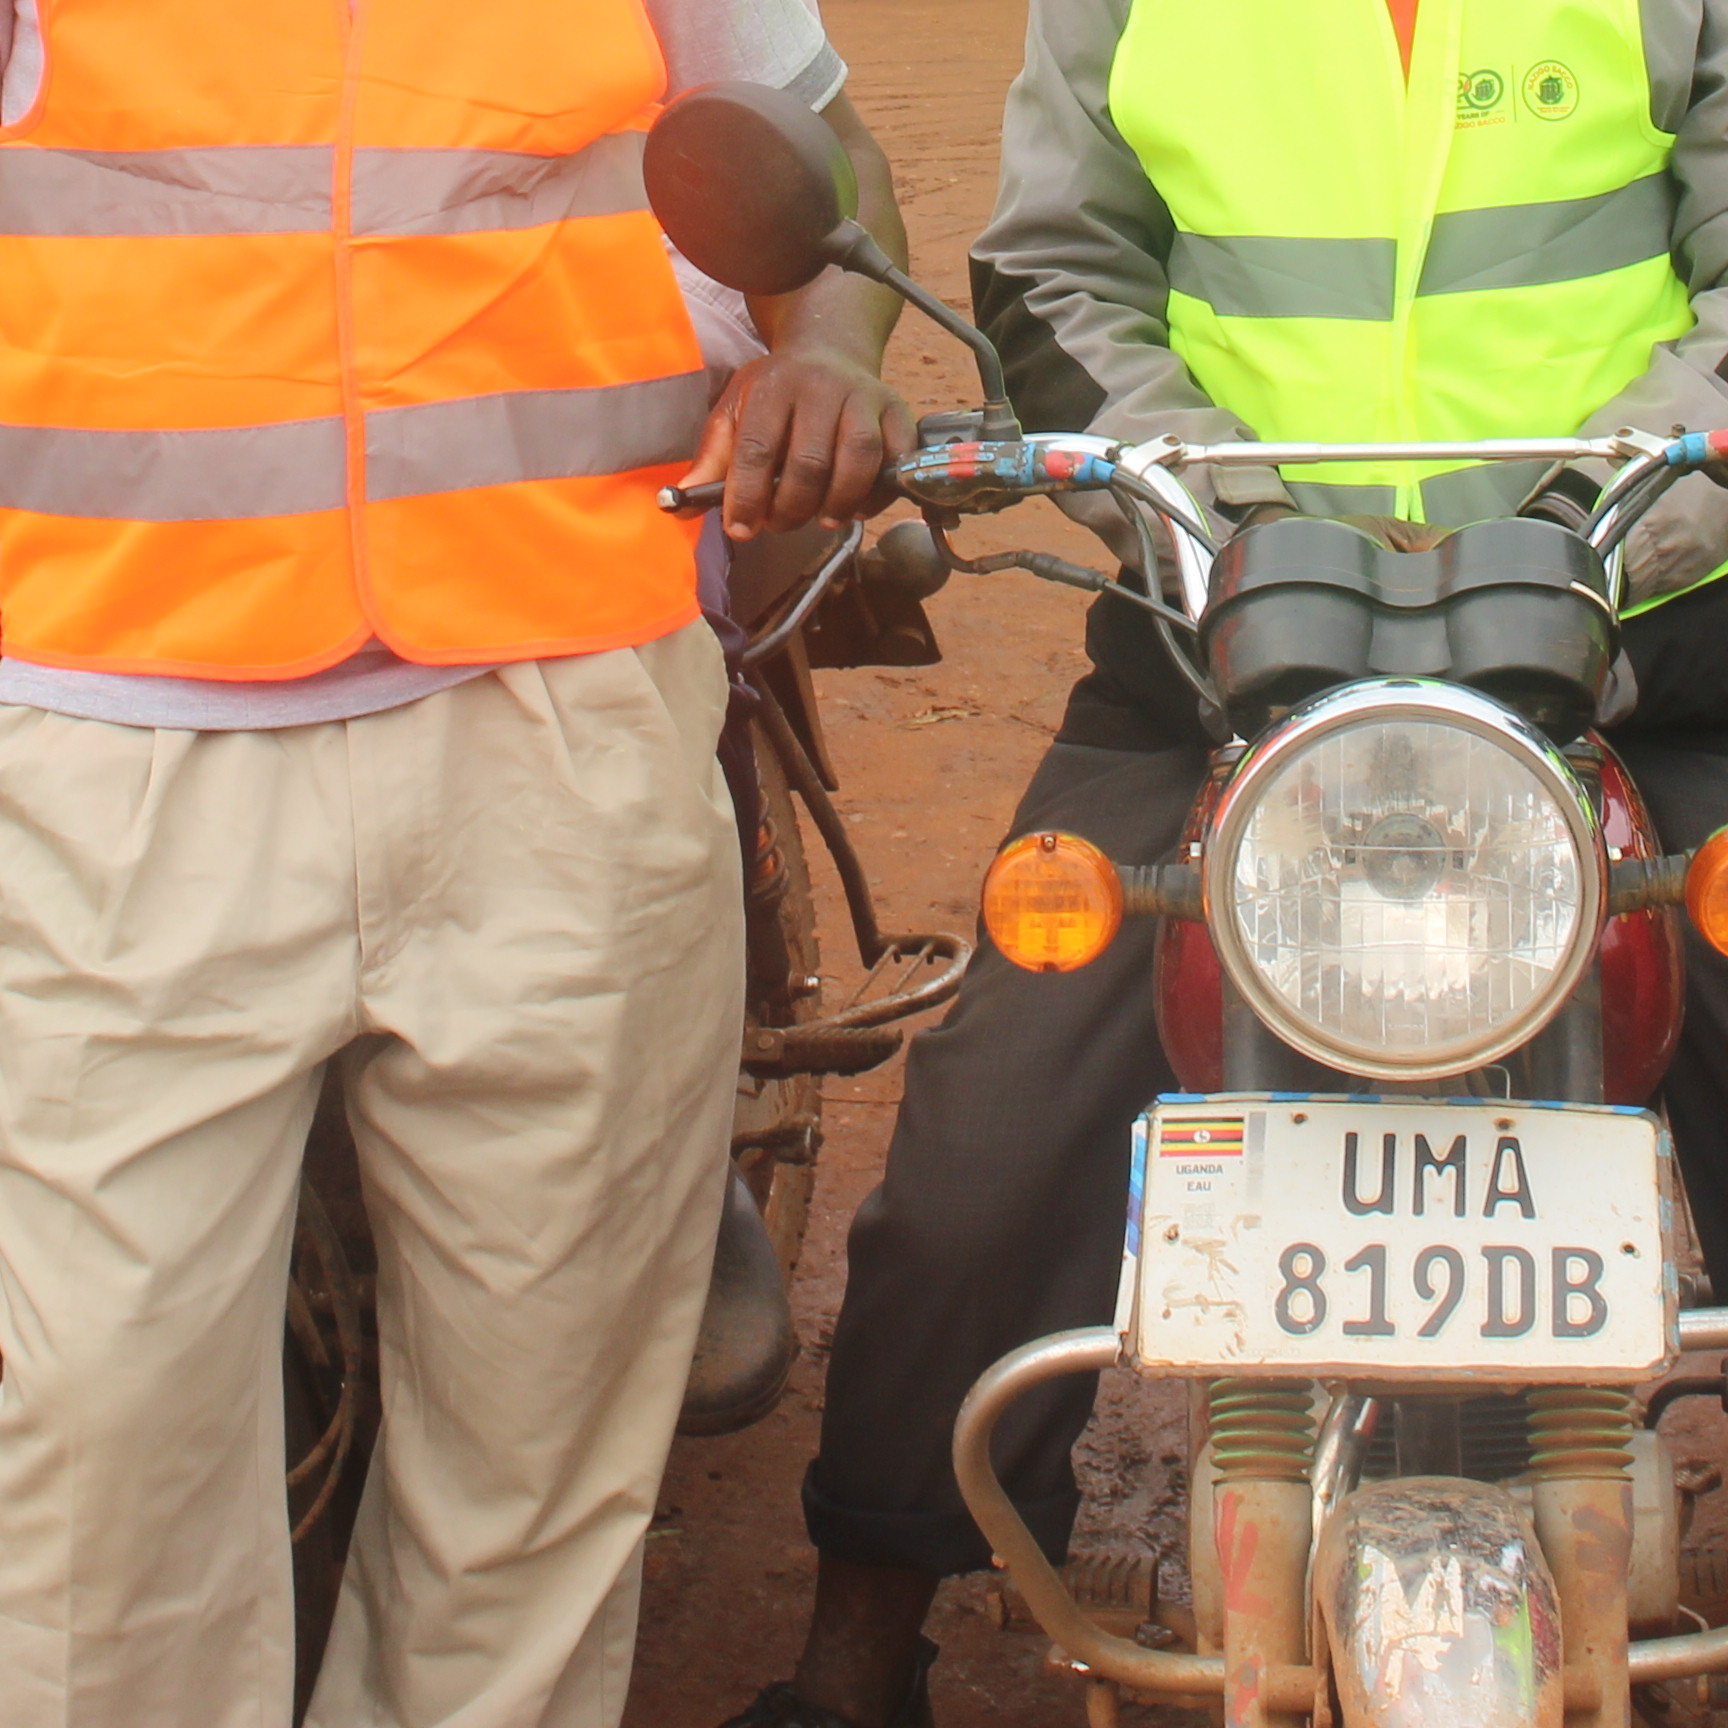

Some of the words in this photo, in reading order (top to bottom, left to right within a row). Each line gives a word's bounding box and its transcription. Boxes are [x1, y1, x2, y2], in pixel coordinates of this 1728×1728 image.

[1528, 65, 1550, 90] NAZIGO
[1552, 65, 1573, 90] SACCO
[1477, 116, 1506, 128] SACCO
[1176, 1164, 1223, 1175] UGANDA
[1342, 1131, 1536, 1220] UMA
[1187, 1181, 1212, 1192] EAU
[1274, 1242, 1609, 1339] 819DB
